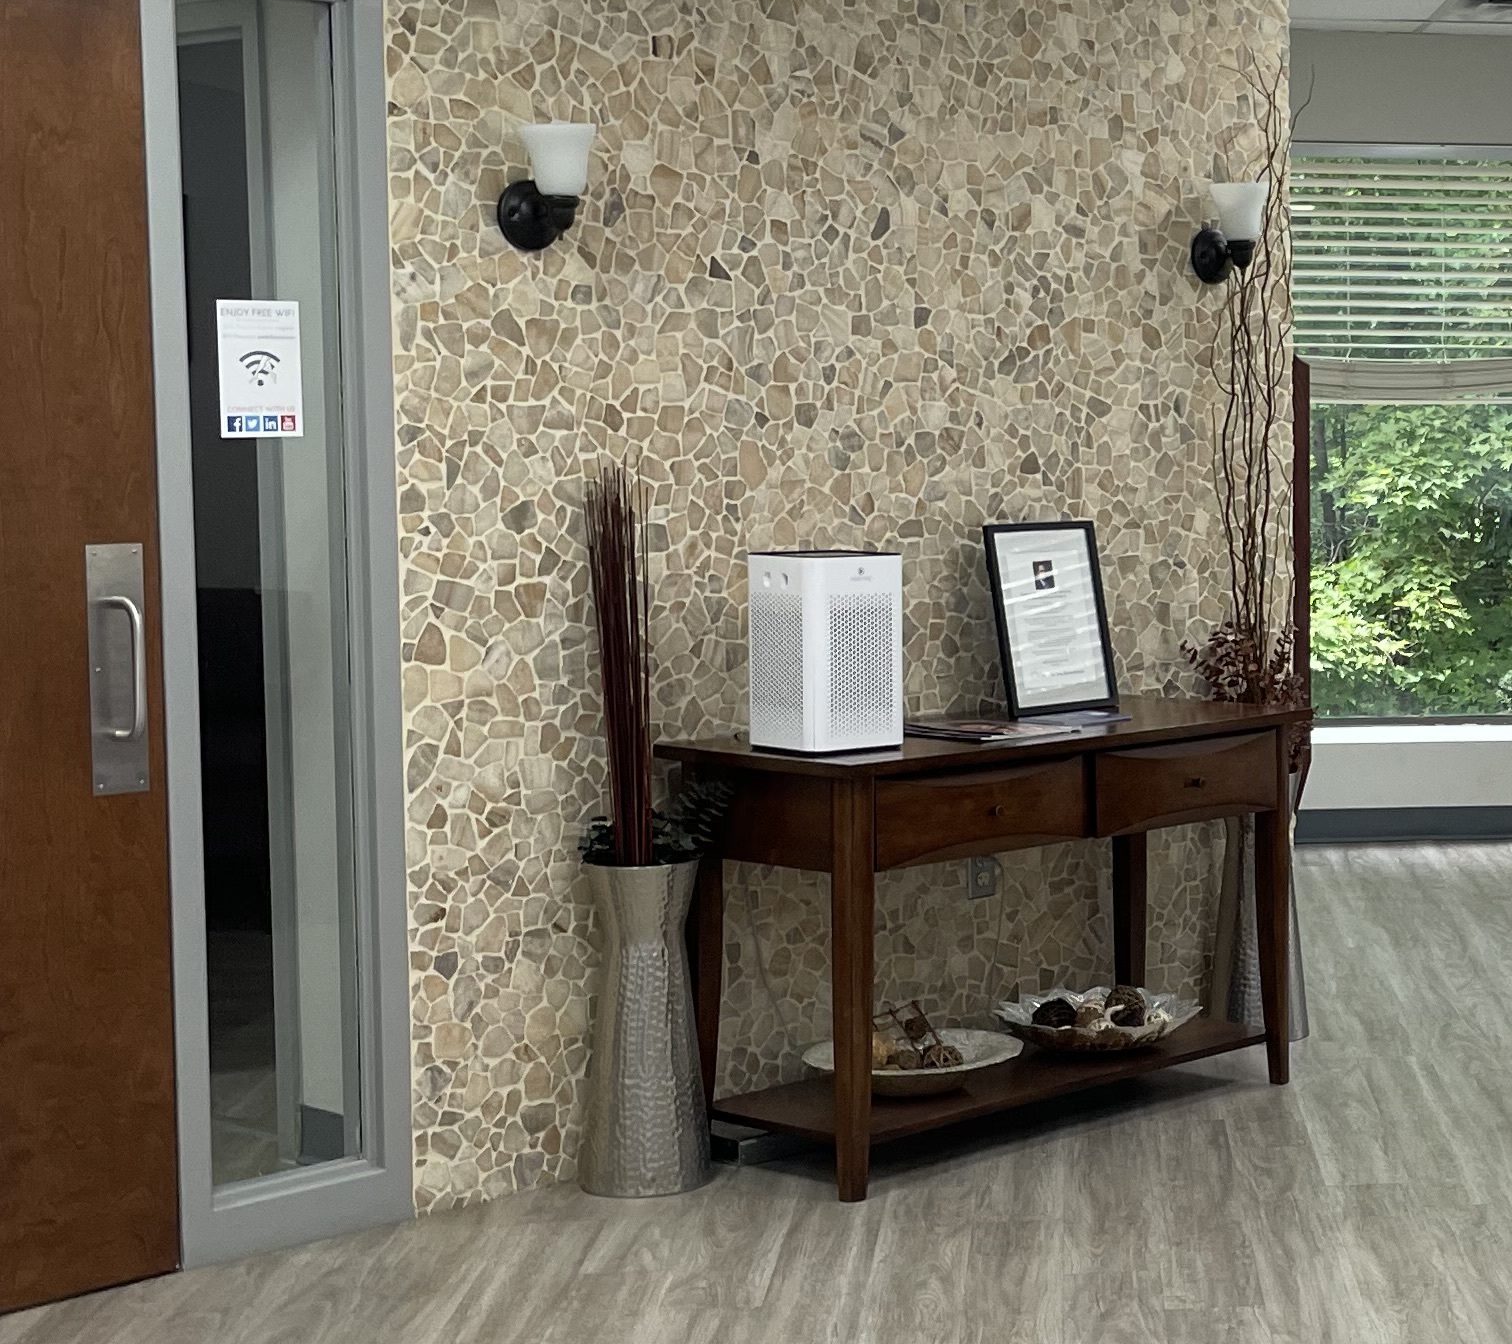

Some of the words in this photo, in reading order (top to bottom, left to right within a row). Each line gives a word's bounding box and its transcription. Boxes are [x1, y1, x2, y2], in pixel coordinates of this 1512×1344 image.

[220, 308, 249, 318] ENJOY
[251, 308, 273, 318] FREE
[264, 417, 277, 430] in
